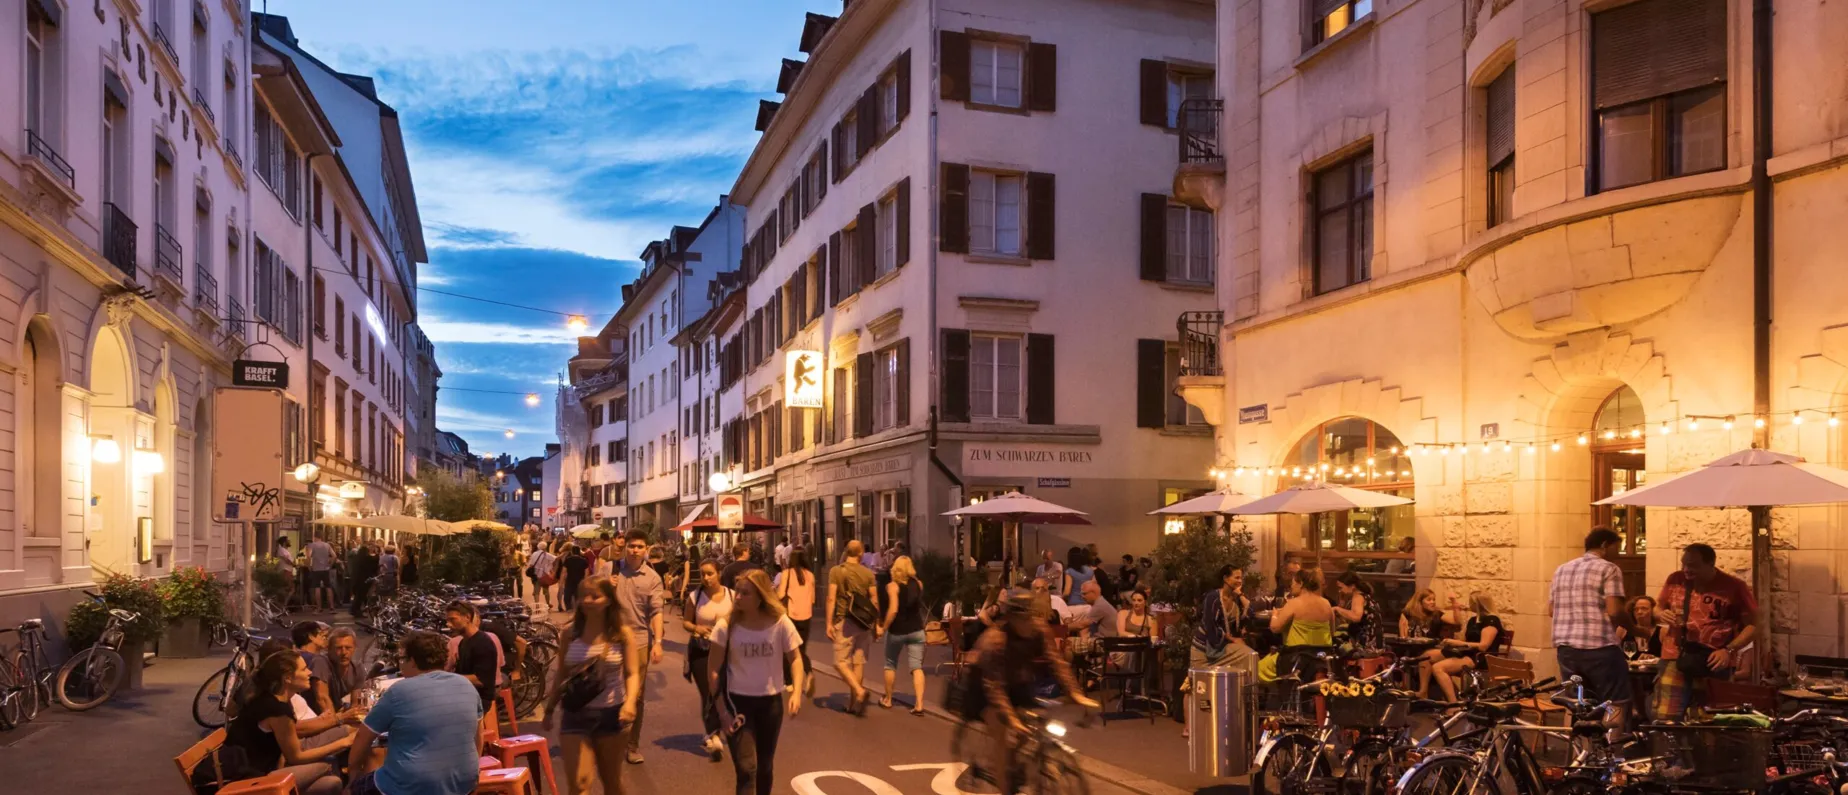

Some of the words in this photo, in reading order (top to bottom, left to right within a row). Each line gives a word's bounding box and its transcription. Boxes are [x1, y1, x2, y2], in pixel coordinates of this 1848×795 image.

[118, 15, 203, 161] KRAFFT
[244, 366, 277, 375] KRAFFT
[970, 449, 991, 461] ZUM
[996, 450, 1054, 462] SCHWARZEN
